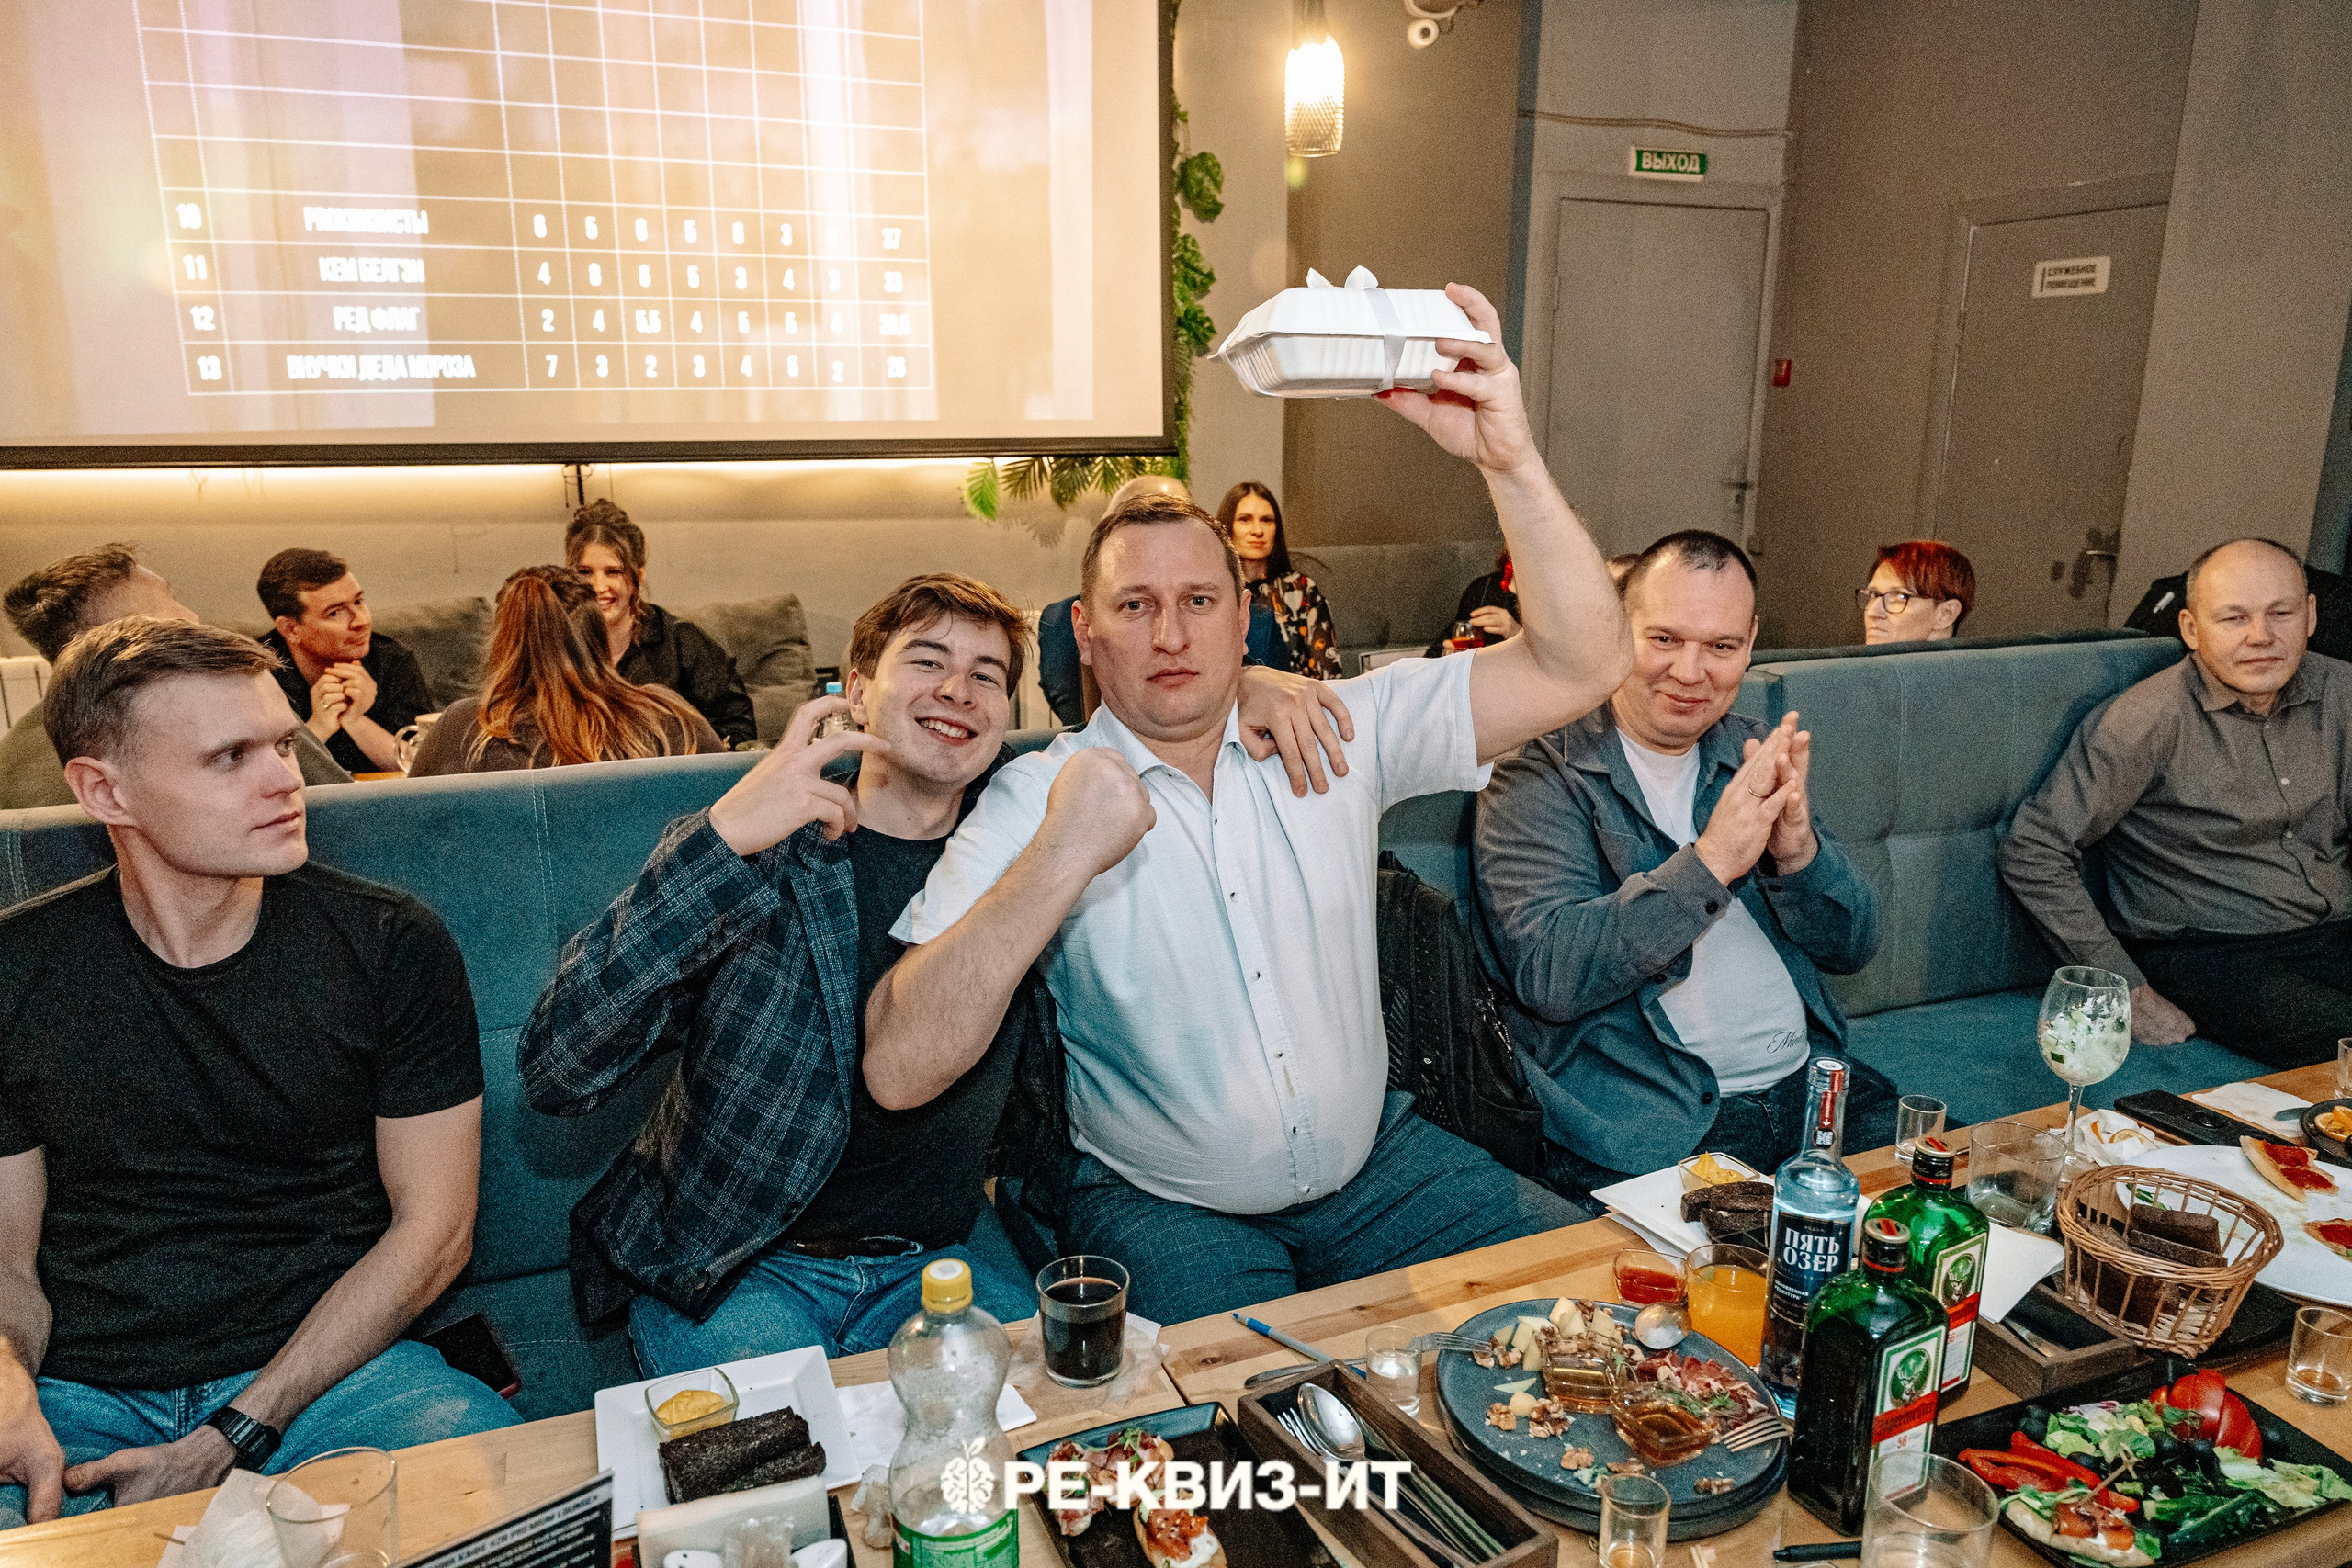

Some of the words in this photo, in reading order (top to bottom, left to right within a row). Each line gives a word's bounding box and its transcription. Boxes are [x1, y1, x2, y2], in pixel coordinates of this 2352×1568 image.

[1642, 152, 1700, 173] ВЫХОД
[780, 223, 793, 246] 3
[183, 254, 208, 280] 11
[537, 262, 551, 285] 4
[735, 266, 748, 290] 3
[782, 268, 795, 290] 4
[190, 305, 216, 331] 12
[541, 309, 554, 332] 2
[593, 309, 605, 332] 4
[690, 310, 703, 333] 4
[197, 355, 222, 380] 13
[357, 355, 409, 381] ДЕДА
[407, 355, 476, 378] МОРОЗА
[545, 355, 558, 378] 7
[595, 355, 609, 378] 3
[645, 355, 658, 378] 2
[693, 355, 706, 378] 3
[740, 355, 753, 378] 4
[831, 360, 844, 383] 2
[1785, 1227, 1840, 1255] ПЯТЬ
[1783, 1247, 1839, 1273] ОЗЕР
